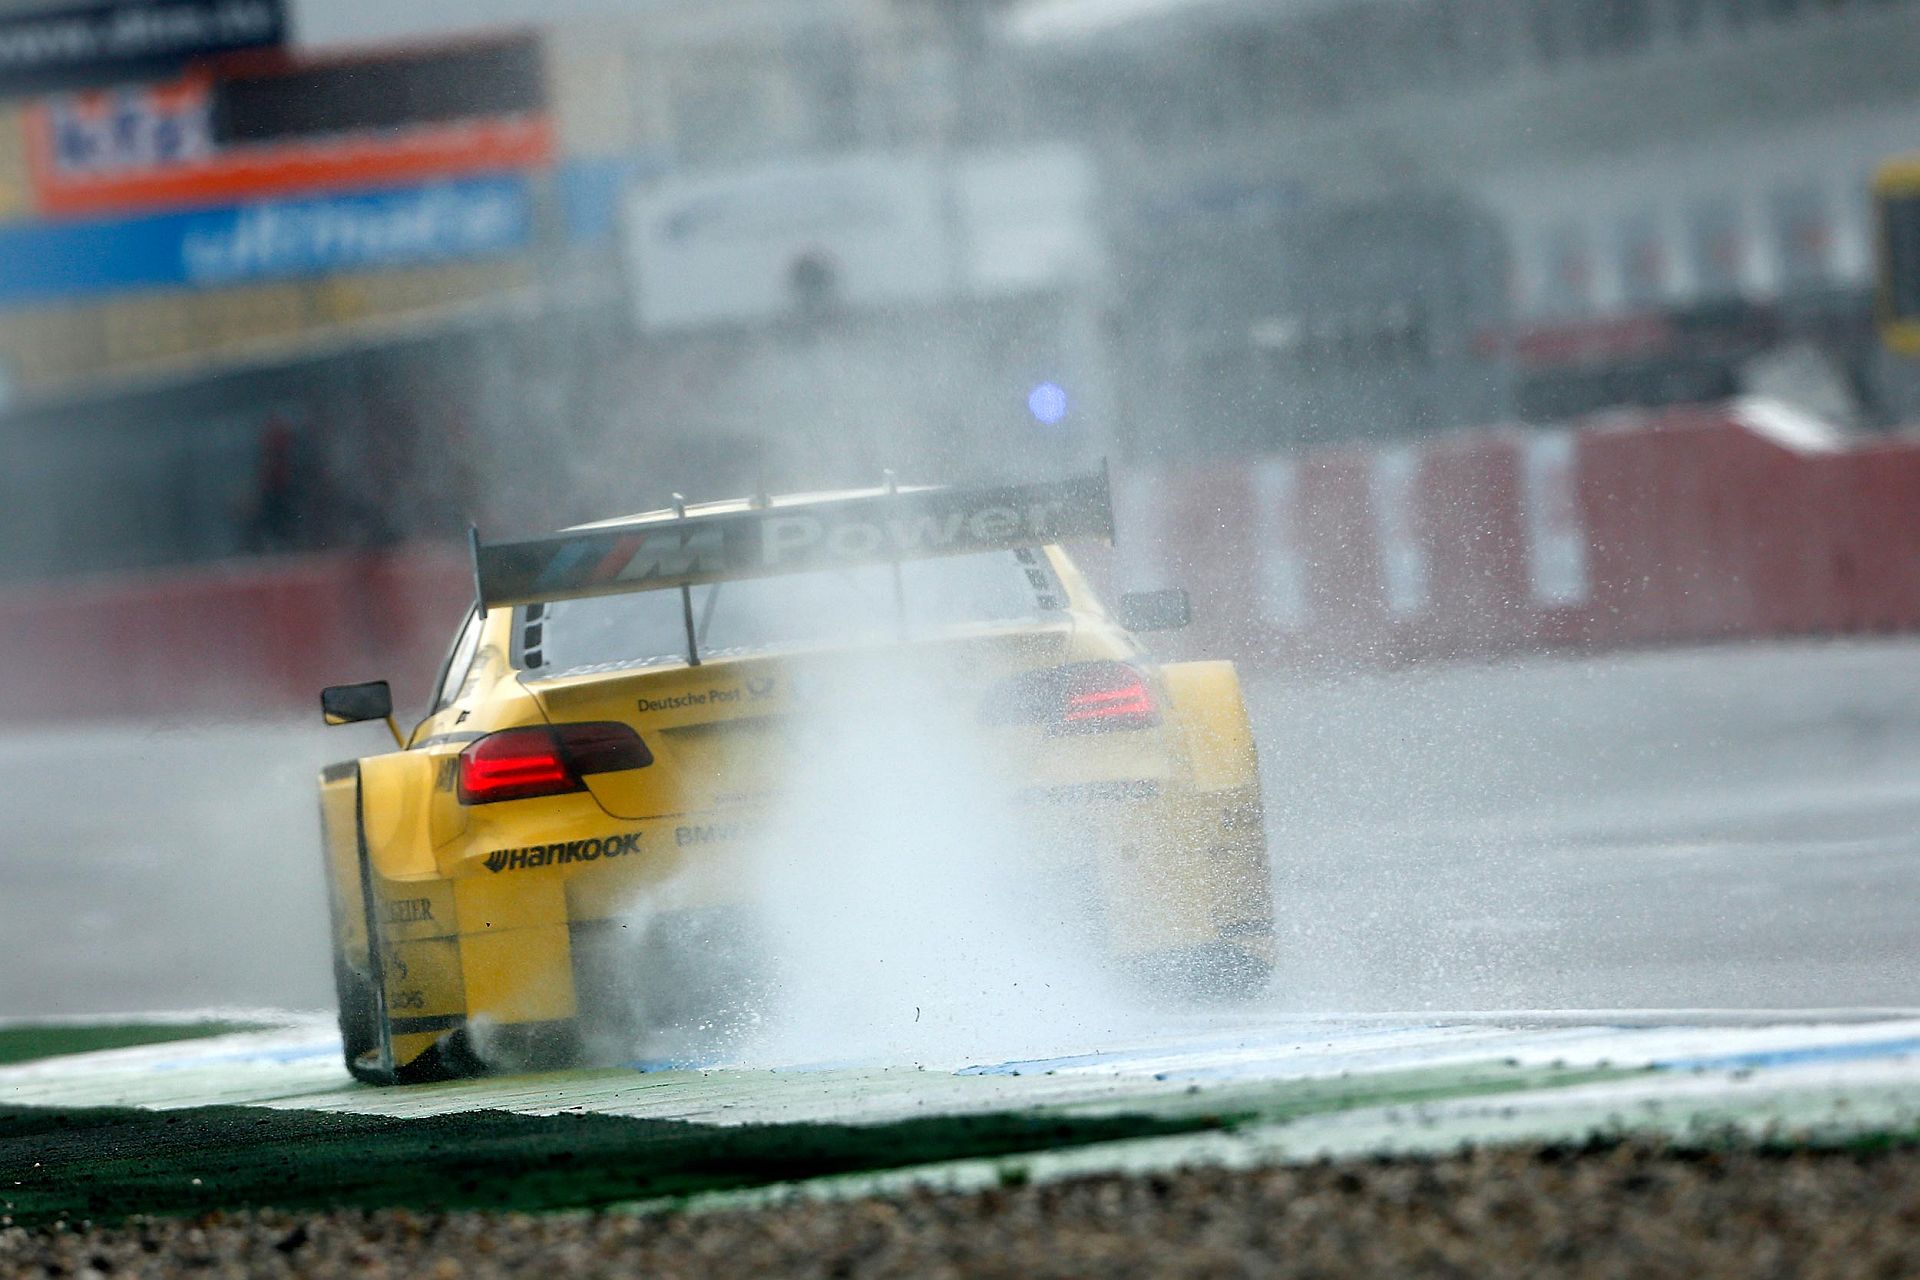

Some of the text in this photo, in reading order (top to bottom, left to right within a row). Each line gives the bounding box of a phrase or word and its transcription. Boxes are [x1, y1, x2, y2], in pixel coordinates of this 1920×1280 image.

[616, 505, 1051, 579] M Power
[638, 688, 738, 712] Deutsche Post
